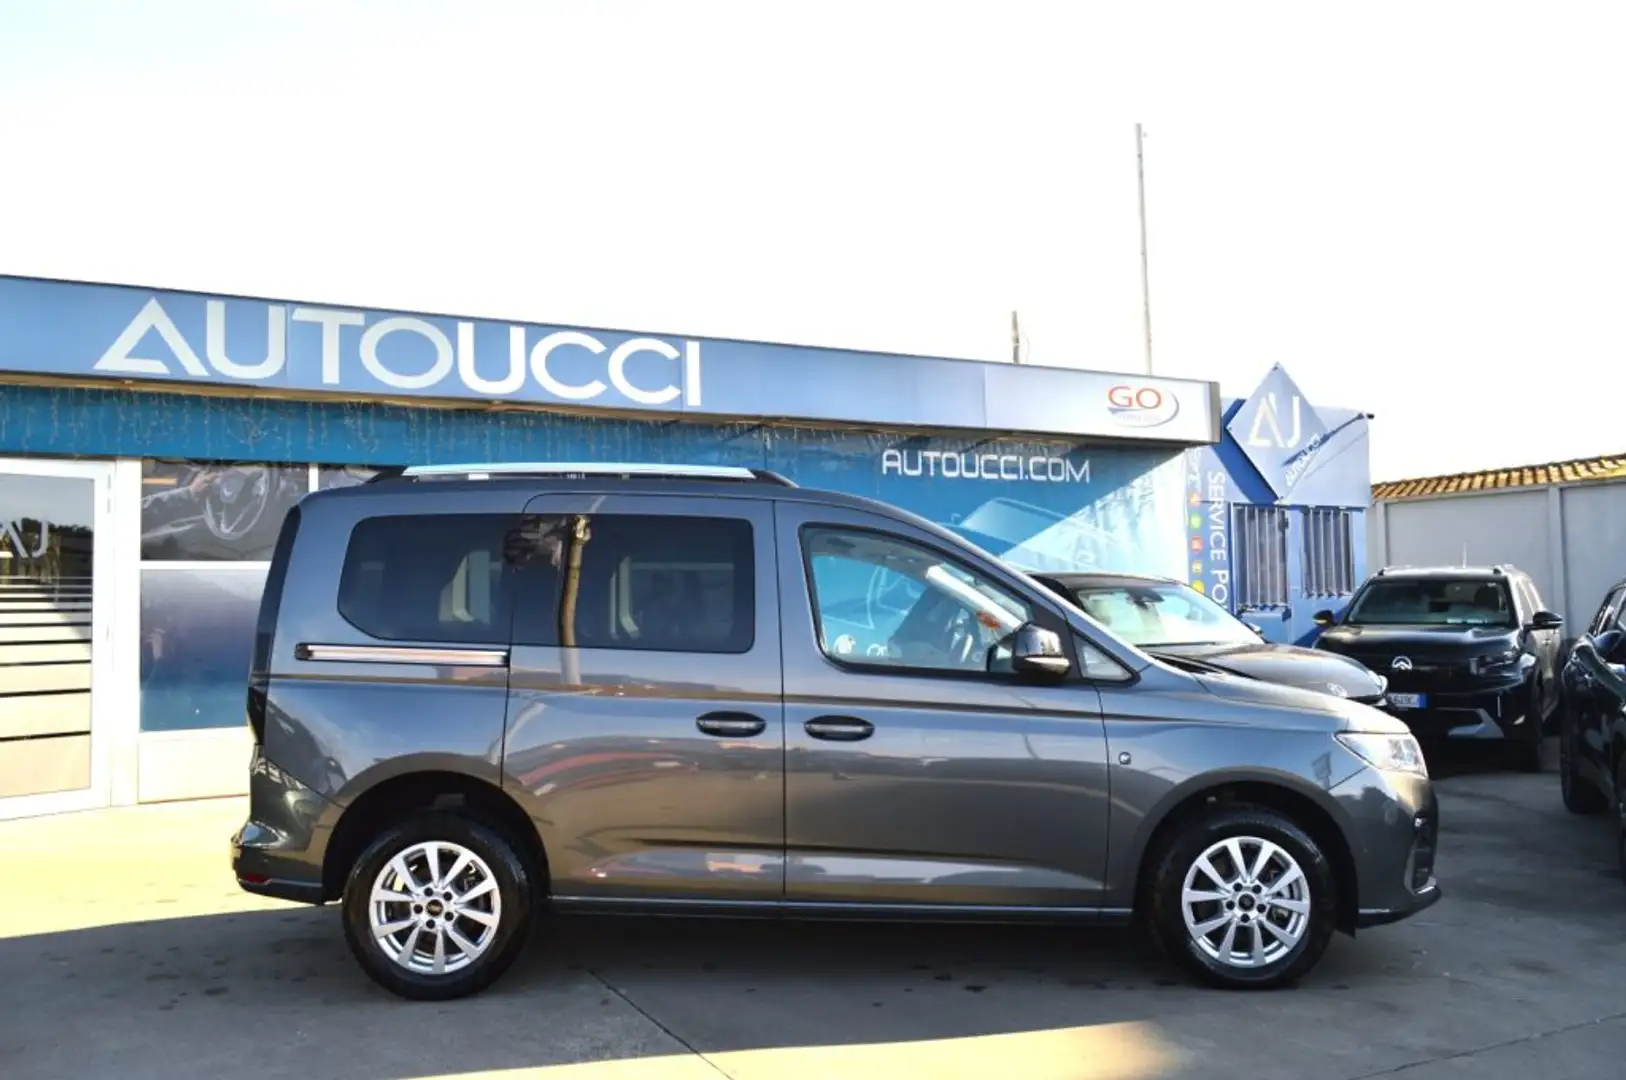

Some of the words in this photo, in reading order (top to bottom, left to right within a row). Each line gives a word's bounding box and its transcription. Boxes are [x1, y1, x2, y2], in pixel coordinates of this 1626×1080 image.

[93, 296, 701, 406] AUTOUCCI
[1108, 386, 1162, 410] GO
[882, 449, 1090, 483] AUTOUCCI.COM
[1208, 470, 1226, 561] SERVICE
[1210, 569, 1230, 609] PO
